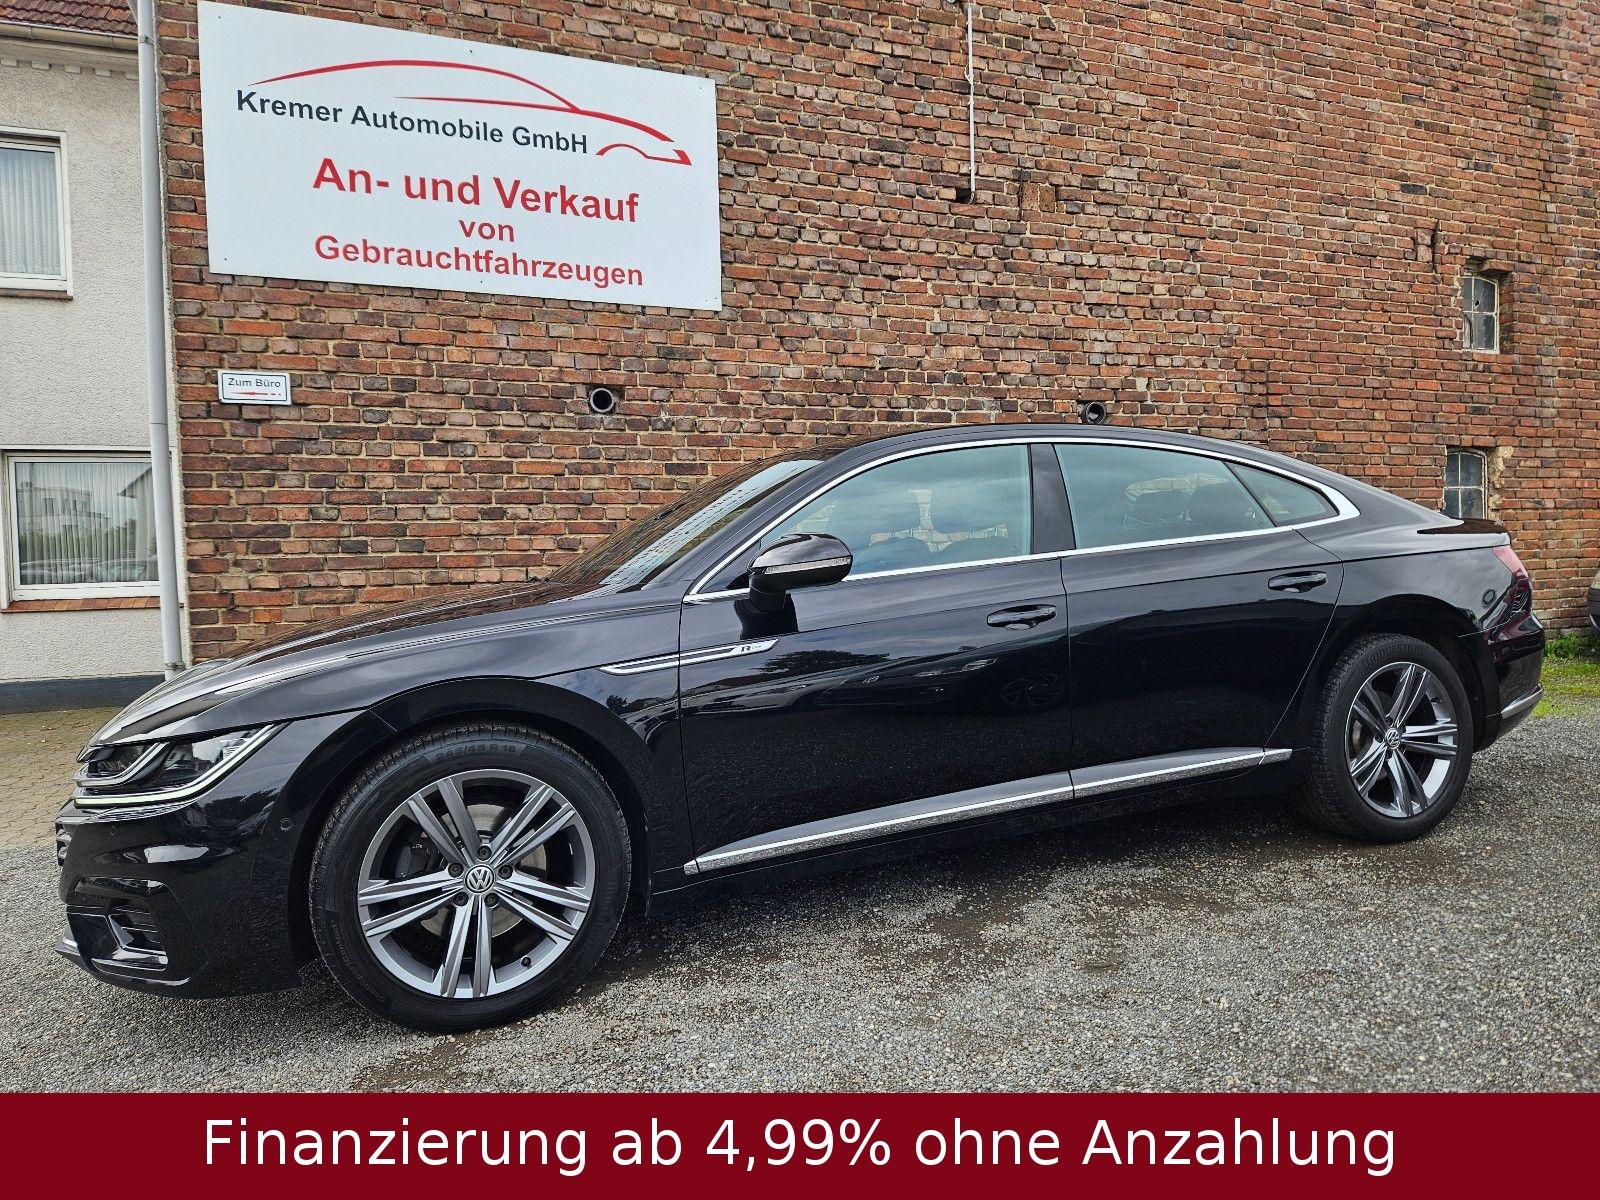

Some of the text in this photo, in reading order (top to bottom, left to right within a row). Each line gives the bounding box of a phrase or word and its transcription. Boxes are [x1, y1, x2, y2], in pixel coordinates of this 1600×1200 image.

[237, 89, 588, 154] Kremer Automobile GmbH
[313, 157, 640, 222] An- und Verkauf
[459, 219, 515, 242] von
[314, 235, 644, 288] Gebrauchtfahrzeugen
[228, 377, 281, 388] Zum Büro
